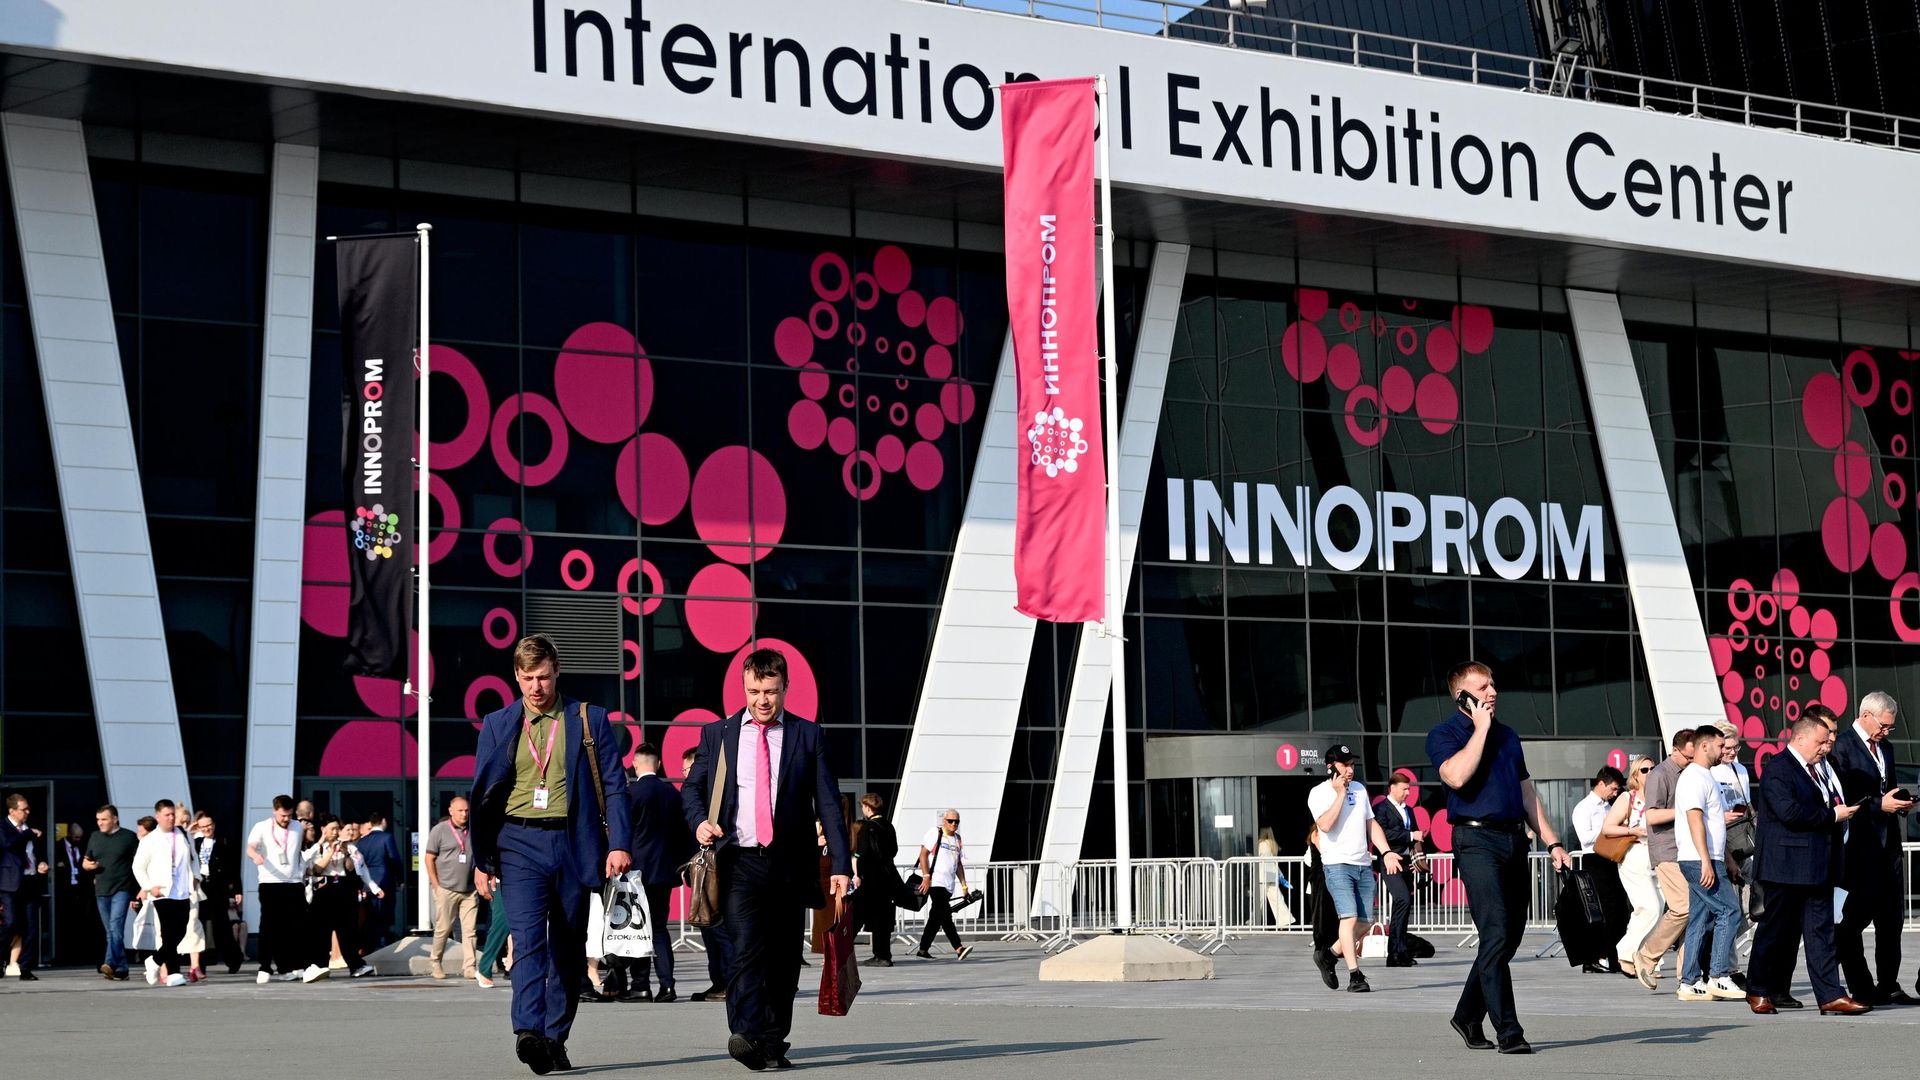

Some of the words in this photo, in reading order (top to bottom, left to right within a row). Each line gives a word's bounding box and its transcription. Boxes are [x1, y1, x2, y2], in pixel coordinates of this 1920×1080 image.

[533, 0, 1132, 150] Internatiol
[1167, 73, 1539, 202] Exhibition
[1566, 131, 1794, 235] Center
[1039, 214, 1060, 395] ИННОПРОМ
[363, 358, 384, 495] INNOPROM
[1167, 477, 1606, 582] INNOPROM
[1283, 749, 1291, 765] 1
[1300, 749, 1318, 757] ВХОД
[1300, 757, 1327, 765] ENTRANC
[1613, 753, 1621, 768] 1
